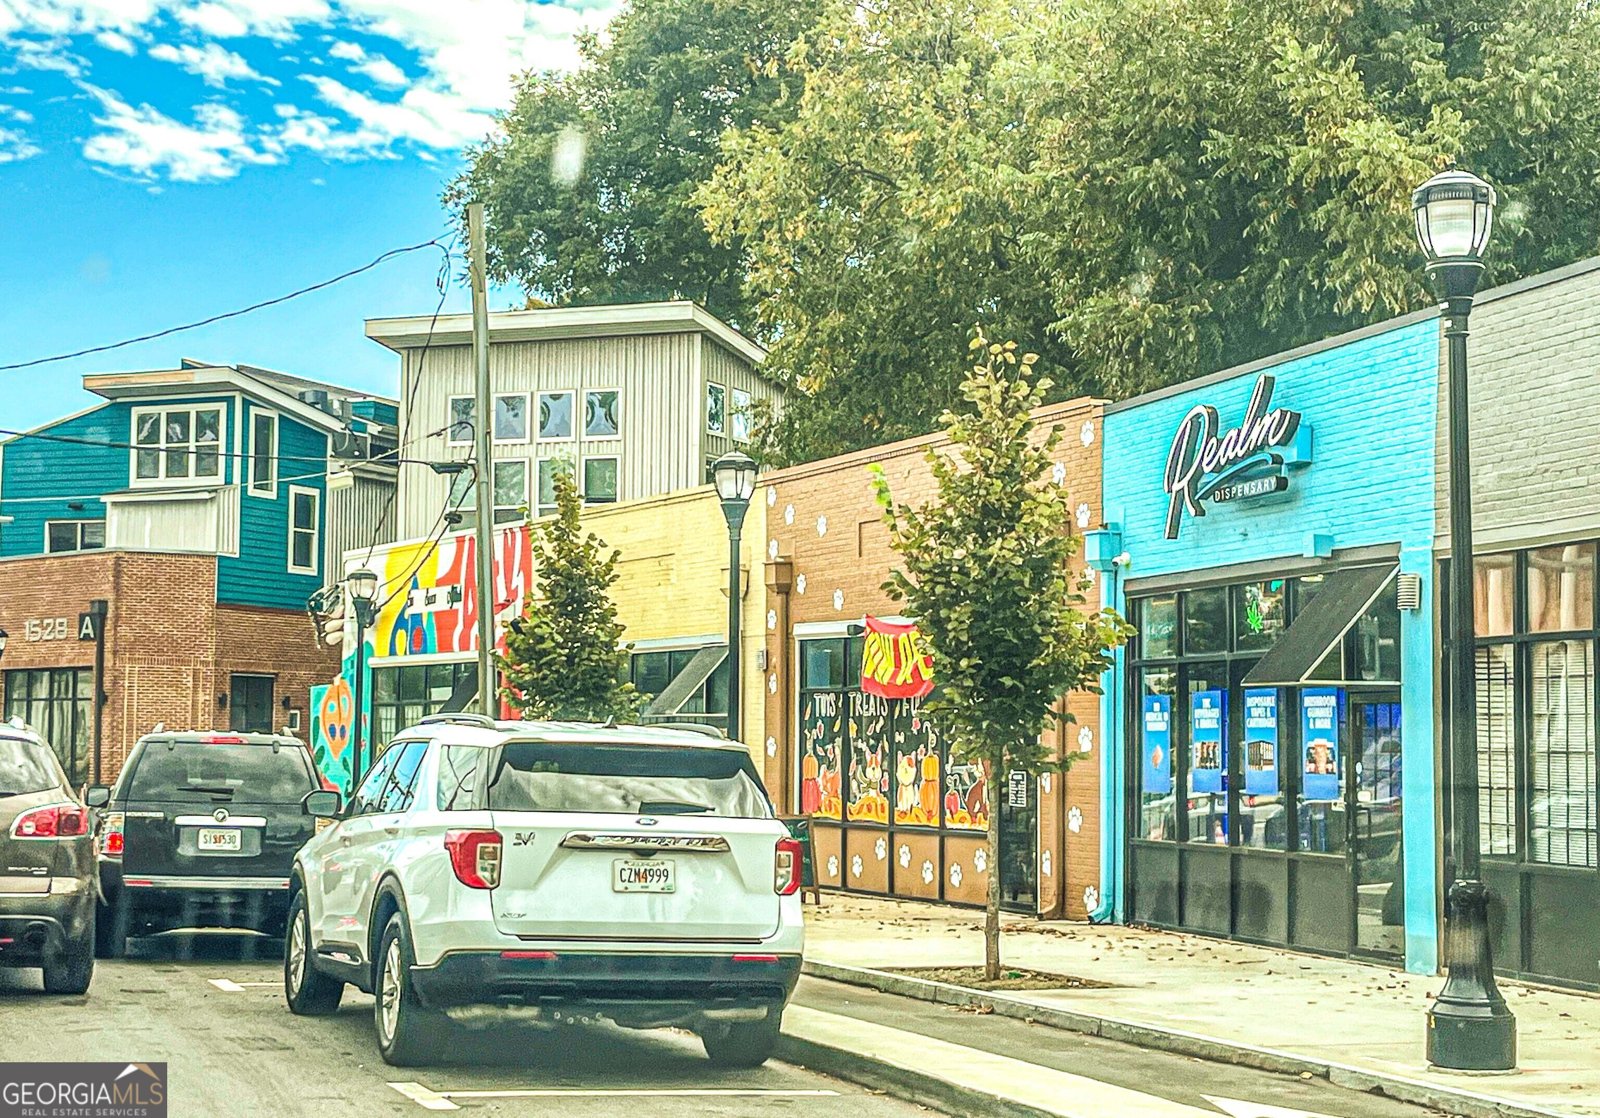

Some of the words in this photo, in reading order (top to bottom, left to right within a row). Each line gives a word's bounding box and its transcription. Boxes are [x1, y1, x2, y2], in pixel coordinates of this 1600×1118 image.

[1164, 374, 1298, 539] Realm
[1215, 478, 1278, 502] DISPENSARY
[25, 618, 68, 642] 1528
[80, 616, 95, 639] A
